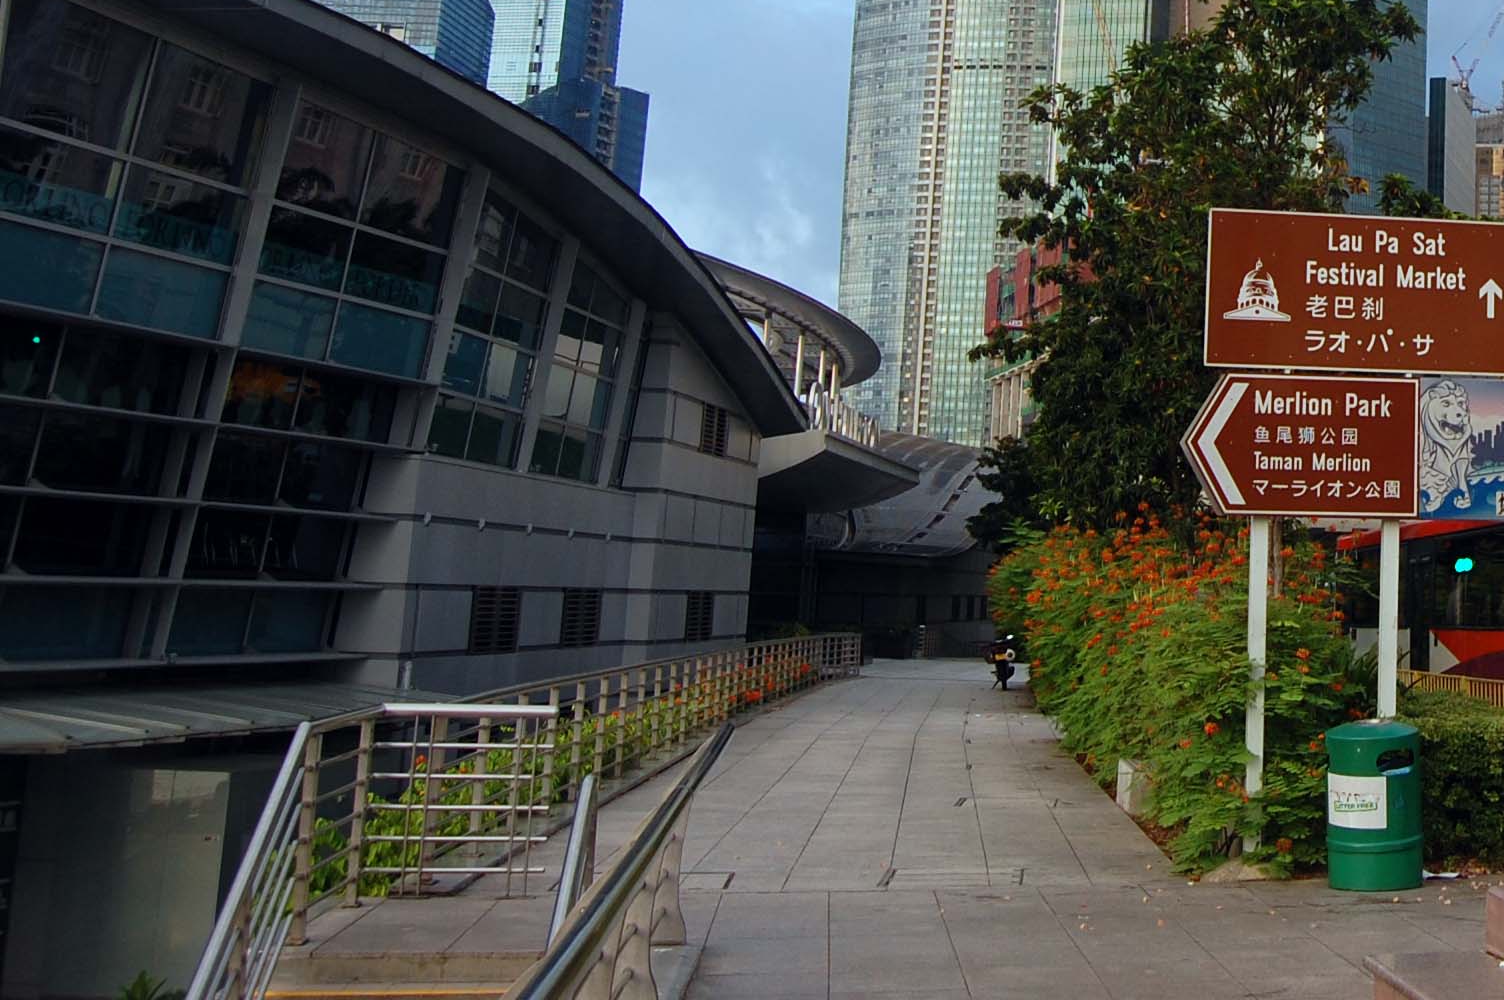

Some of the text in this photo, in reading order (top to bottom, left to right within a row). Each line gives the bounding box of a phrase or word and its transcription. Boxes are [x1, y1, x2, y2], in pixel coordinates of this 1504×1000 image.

[1328, 227, 1446, 256] Lau Pa Sat
[1305, 260, 1466, 290] Festival Market
[1305, 294, 1384, 321] 老巴刹
[1254, 389, 1391, 417] Merlion Park
[1253, 425, 1358, 446] 鱼尾狮公园
[1253, 451, 1371, 473] Taman Merlion
[1252, 479, 1401, 499] マーライオン公園
